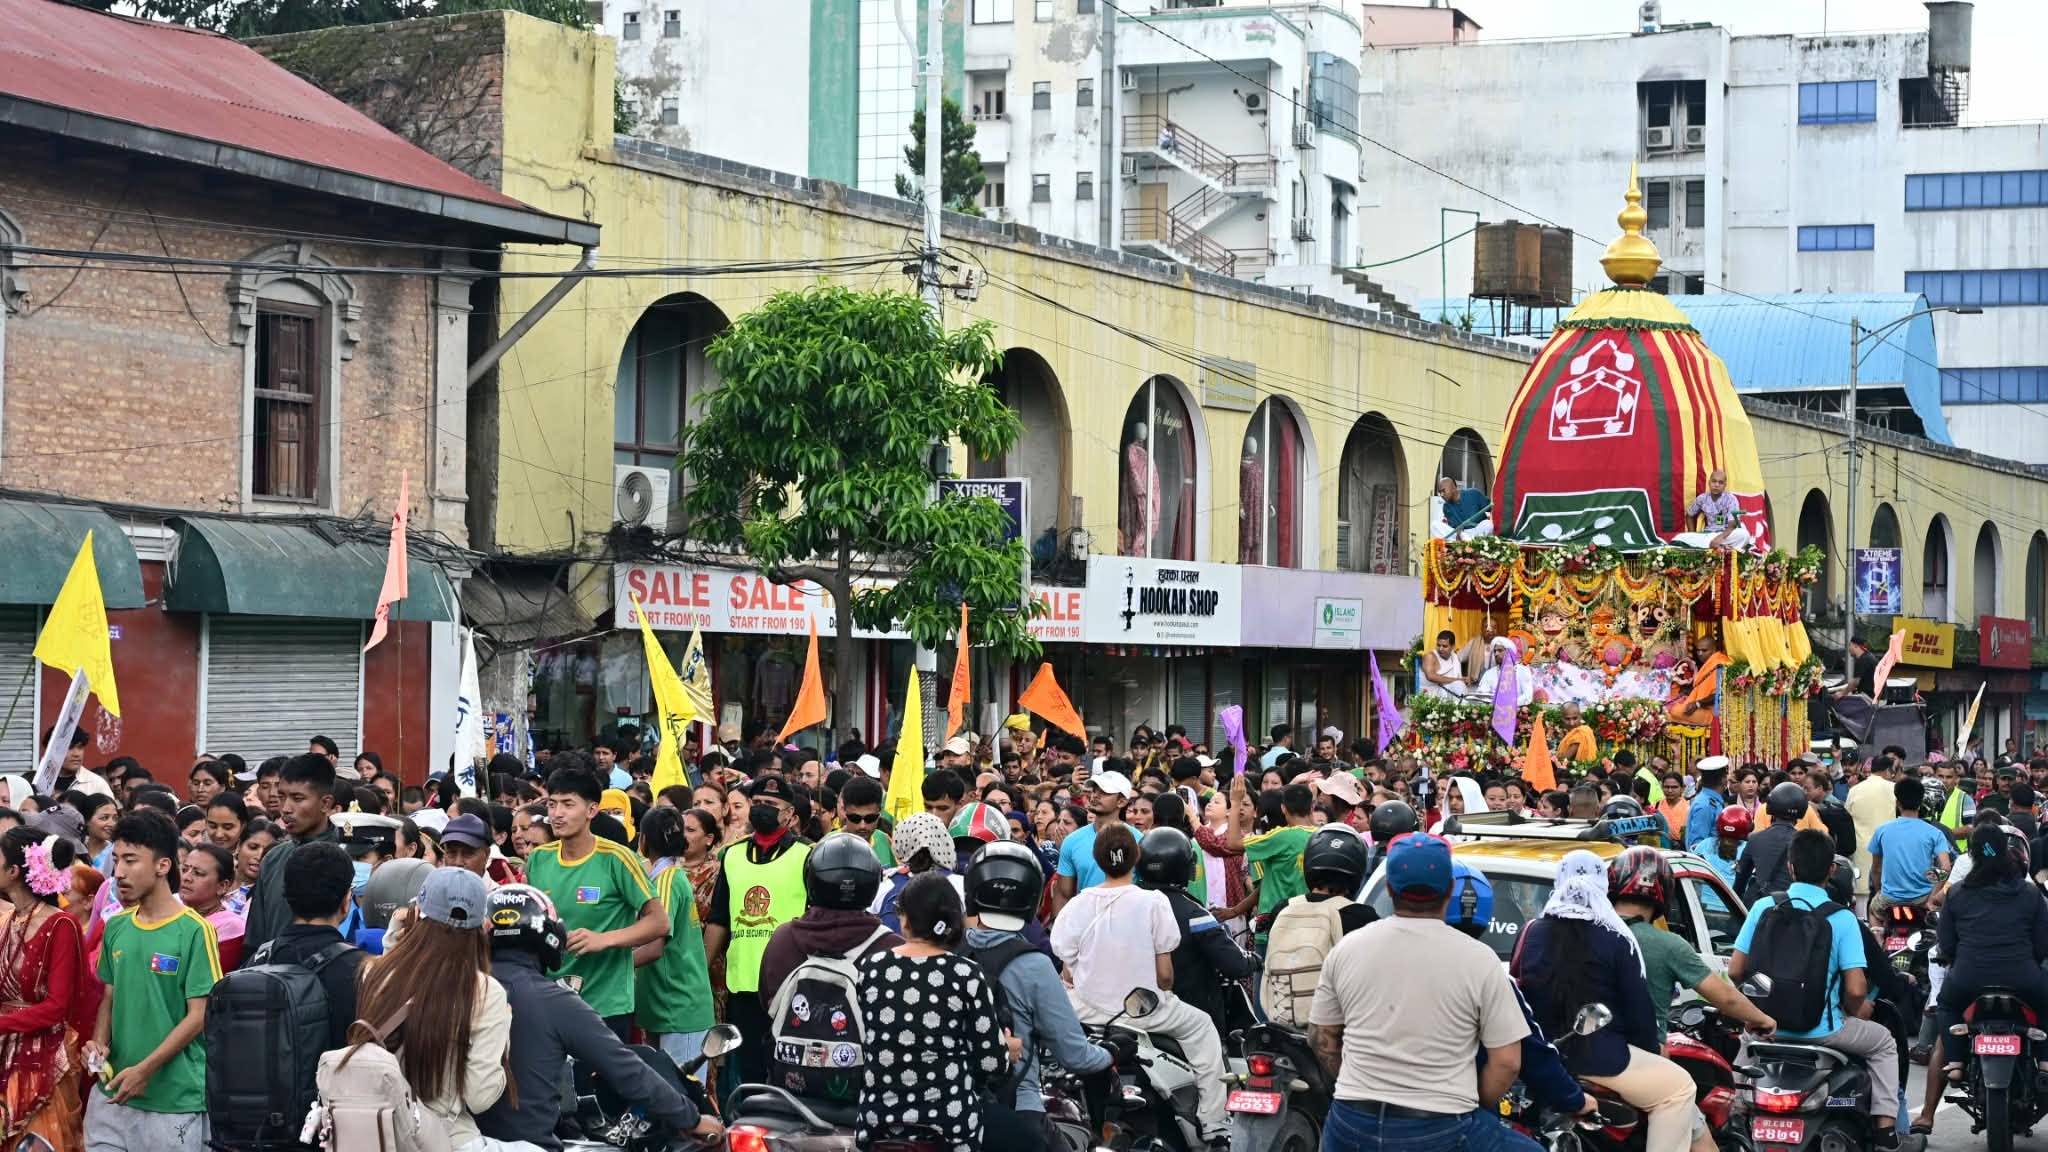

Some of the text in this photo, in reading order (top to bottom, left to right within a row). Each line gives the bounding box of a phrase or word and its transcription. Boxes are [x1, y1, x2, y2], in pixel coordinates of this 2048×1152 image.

[955, 483, 1006, 498] XTREME
[627, 568, 710, 607] SALE
[730, 575, 805, 611] SALE
[1140, 586, 1218, 616] HOOKAH SHOP
[664, 612, 691, 627] FROM
[730, 616, 805, 630] START FROM 190
[1046, 626, 1066, 638] FROM
[1068, 626, 1080, 638] 190
